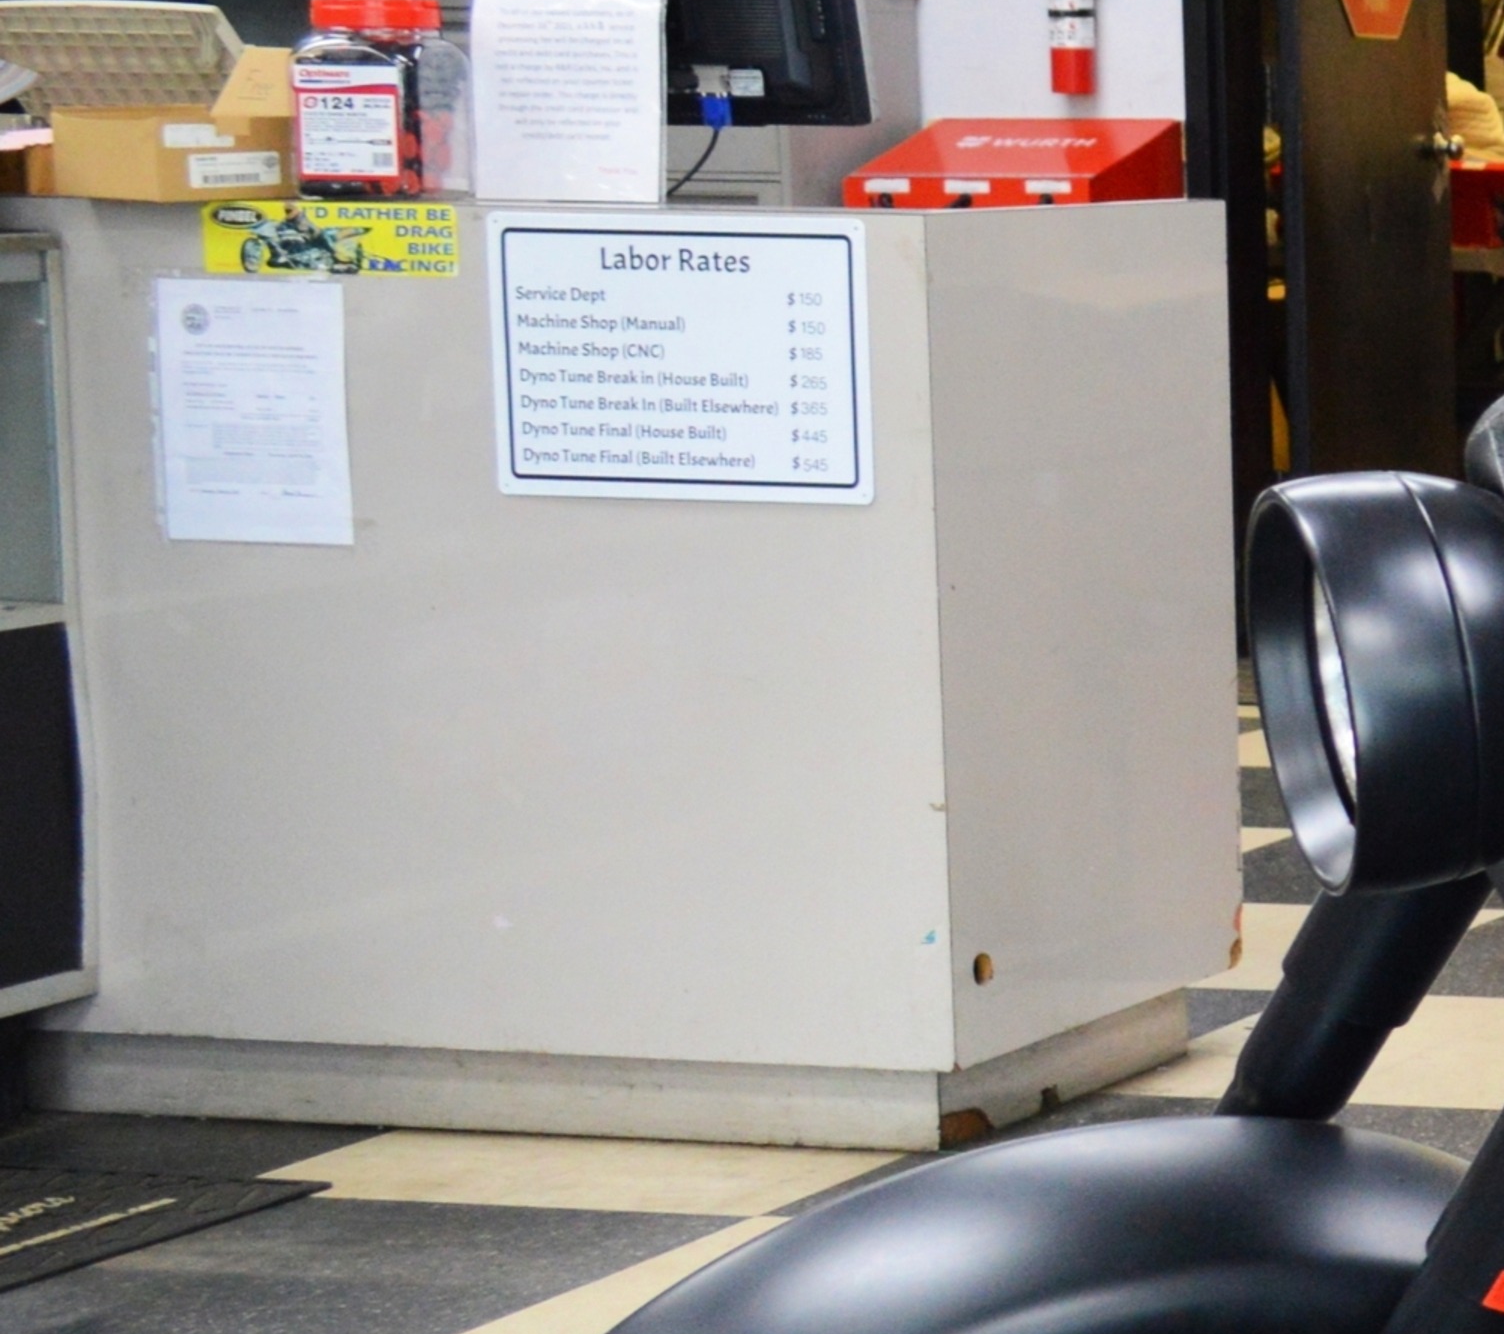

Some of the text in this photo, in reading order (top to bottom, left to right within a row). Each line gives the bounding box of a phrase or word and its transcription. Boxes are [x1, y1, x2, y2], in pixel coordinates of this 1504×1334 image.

[337, 207, 417, 221] RATHER
[426, 208, 452, 222] BE
[395, 225, 454, 239] DRAG
[407, 242, 454, 255] BIKE
[599, 245, 752, 274] Labor Rates
[515, 285, 567, 302] Service
[570, 286, 606, 305] Dept
[516, 314, 578, 330] Machine
[580, 315, 618, 333] Shop
[620, 316, 686, 334] (Manual)
[518, 341, 579, 358] Machine
[581, 342, 620, 360] Shop
[622, 343, 666, 361] (CNC)
[519, 368, 556, 387] Dyno
[558, 369, 594, 385] Tune
[596, 370, 638, 386] Break
[640, 371, 655, 386] in
[657, 371, 706, 388] (House
[709, 372, 749, 390] Built)
[520, 395, 557, 413] Dyno
[560, 396, 595, 411] Tune
[597, 396, 639, 412] Break
[641, 397, 657, 412] In
[659, 397, 698, 414] (Built
[701, 399, 780, 417] Elsewhere)
[521, 421, 559, 440] Dyno
[561, 423, 596, 438] Tune
[598, 423, 633, 438] Final
[635, 424, 686, 440] (House
[688, 425, 727, 442] Built)
[523, 448, 560, 466] Dyno
[562, 449, 597, 464] Tune
[599, 449, 634, 465] Final
[636, 450, 675, 468] (Built
[678, 452, 756, 470] Elsewhere)
